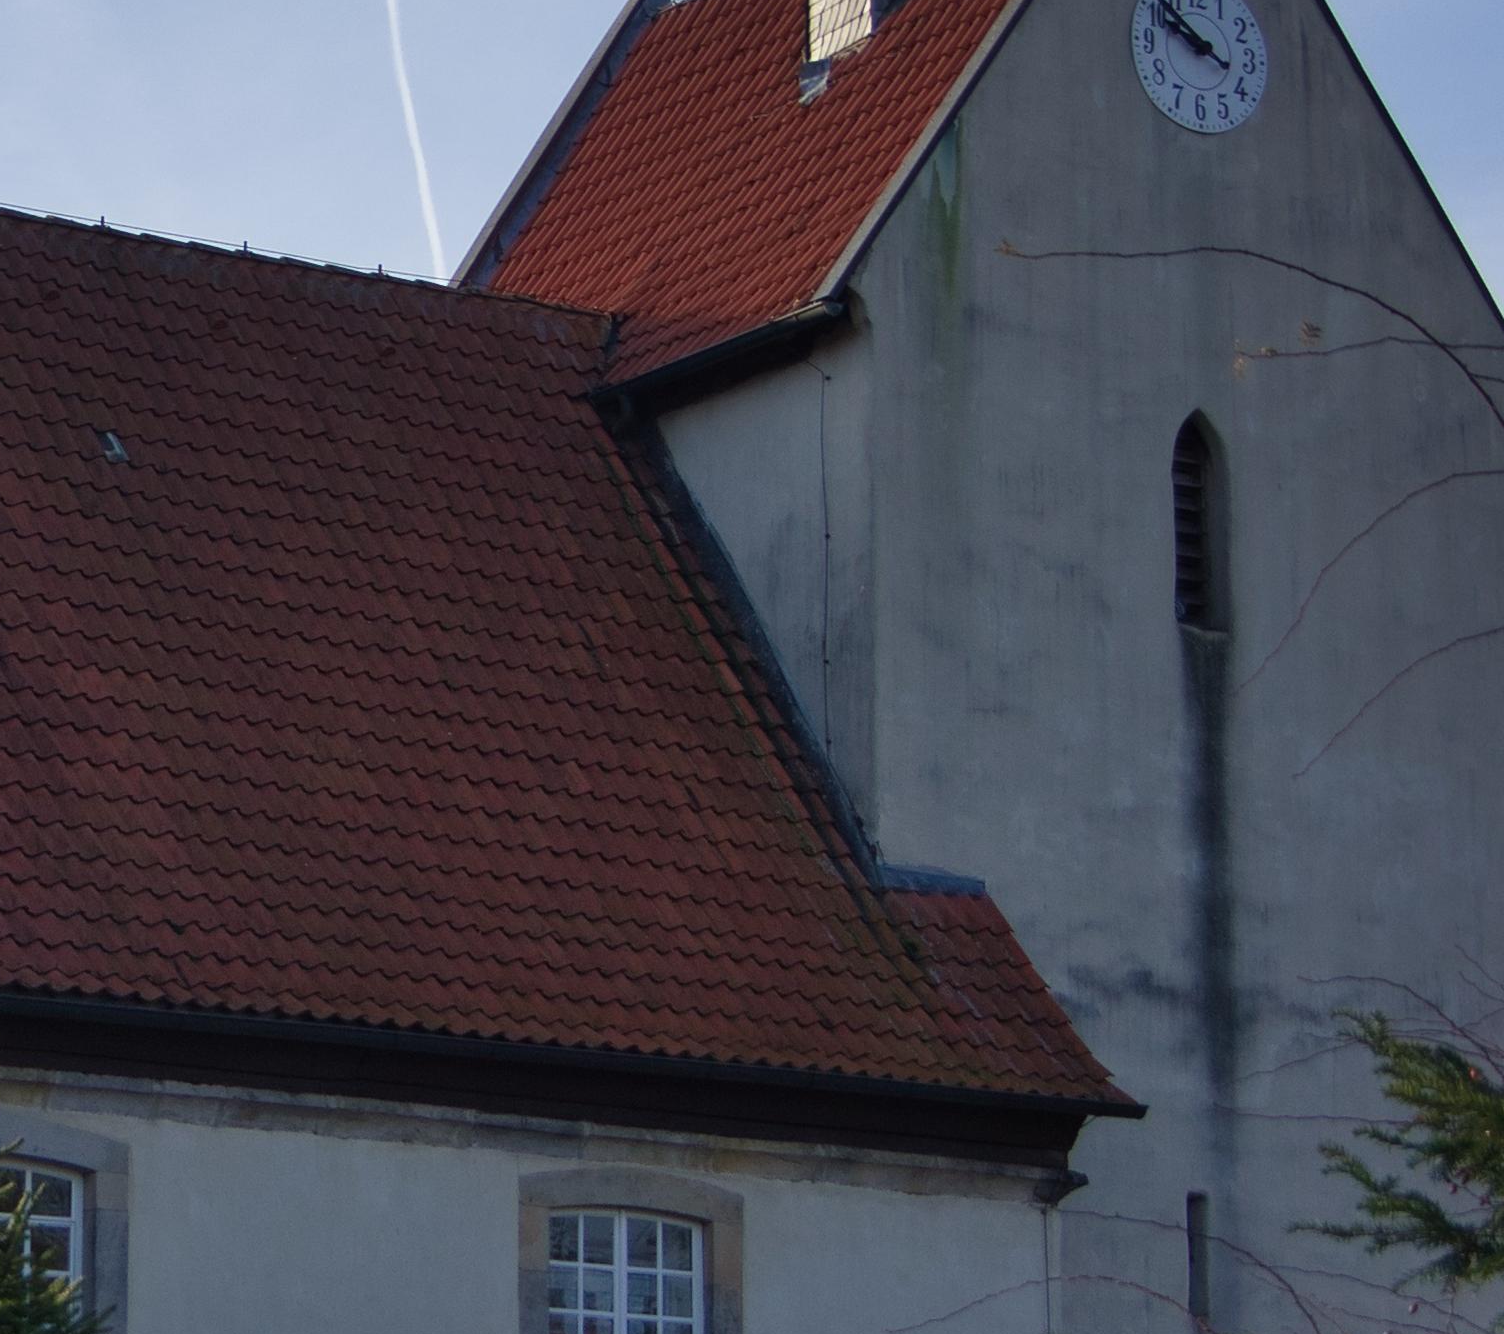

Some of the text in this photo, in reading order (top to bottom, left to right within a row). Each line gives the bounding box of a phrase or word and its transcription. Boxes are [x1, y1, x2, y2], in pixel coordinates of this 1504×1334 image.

[1147, 1, 1166, 29] 10
[1143, 27, 1155, 54] 9
[1233, 17, 1248, 44] 2
[1152, 58, 1165, 85] 8
[1242, 48, 1256, 74] 3
[1172, 83, 1184, 109] 7
[1233, 76, 1248, 102] 4
[1195, 93, 1206, 120] 6
[1217, 93, 1229, 120] 5
